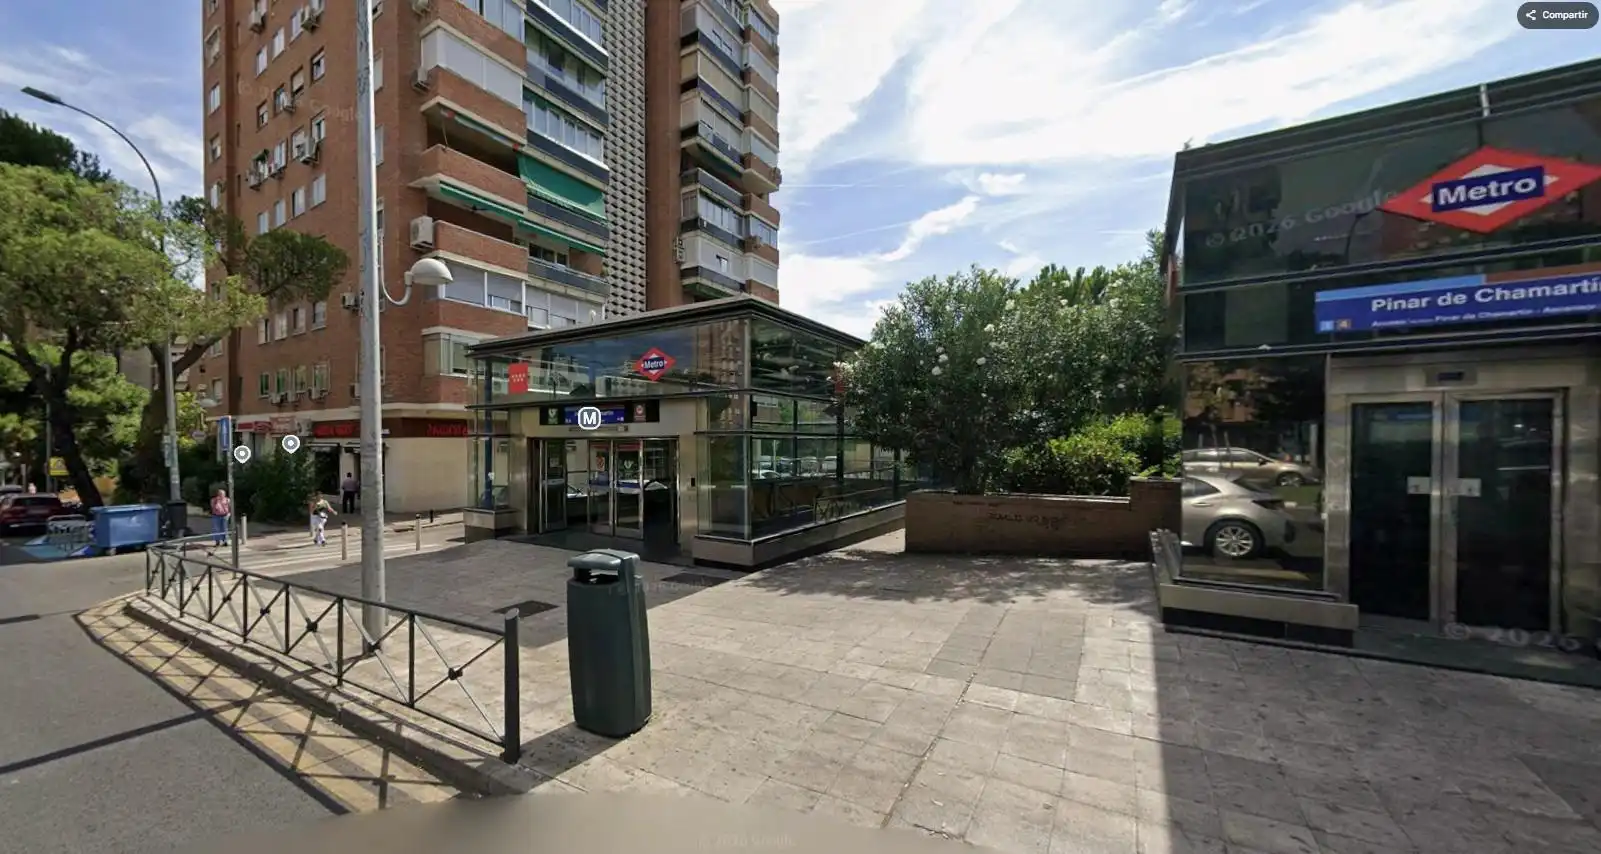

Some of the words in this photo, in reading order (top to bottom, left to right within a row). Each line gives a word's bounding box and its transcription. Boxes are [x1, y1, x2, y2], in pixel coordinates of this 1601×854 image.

[1438, 175, 1539, 206] Metro
[1371, 295, 1431, 313] Pinar
[1437, 291, 1467, 307] de
[1474, 277, 1601, 304] Chamartí
[644, 360, 664, 370] Metro
